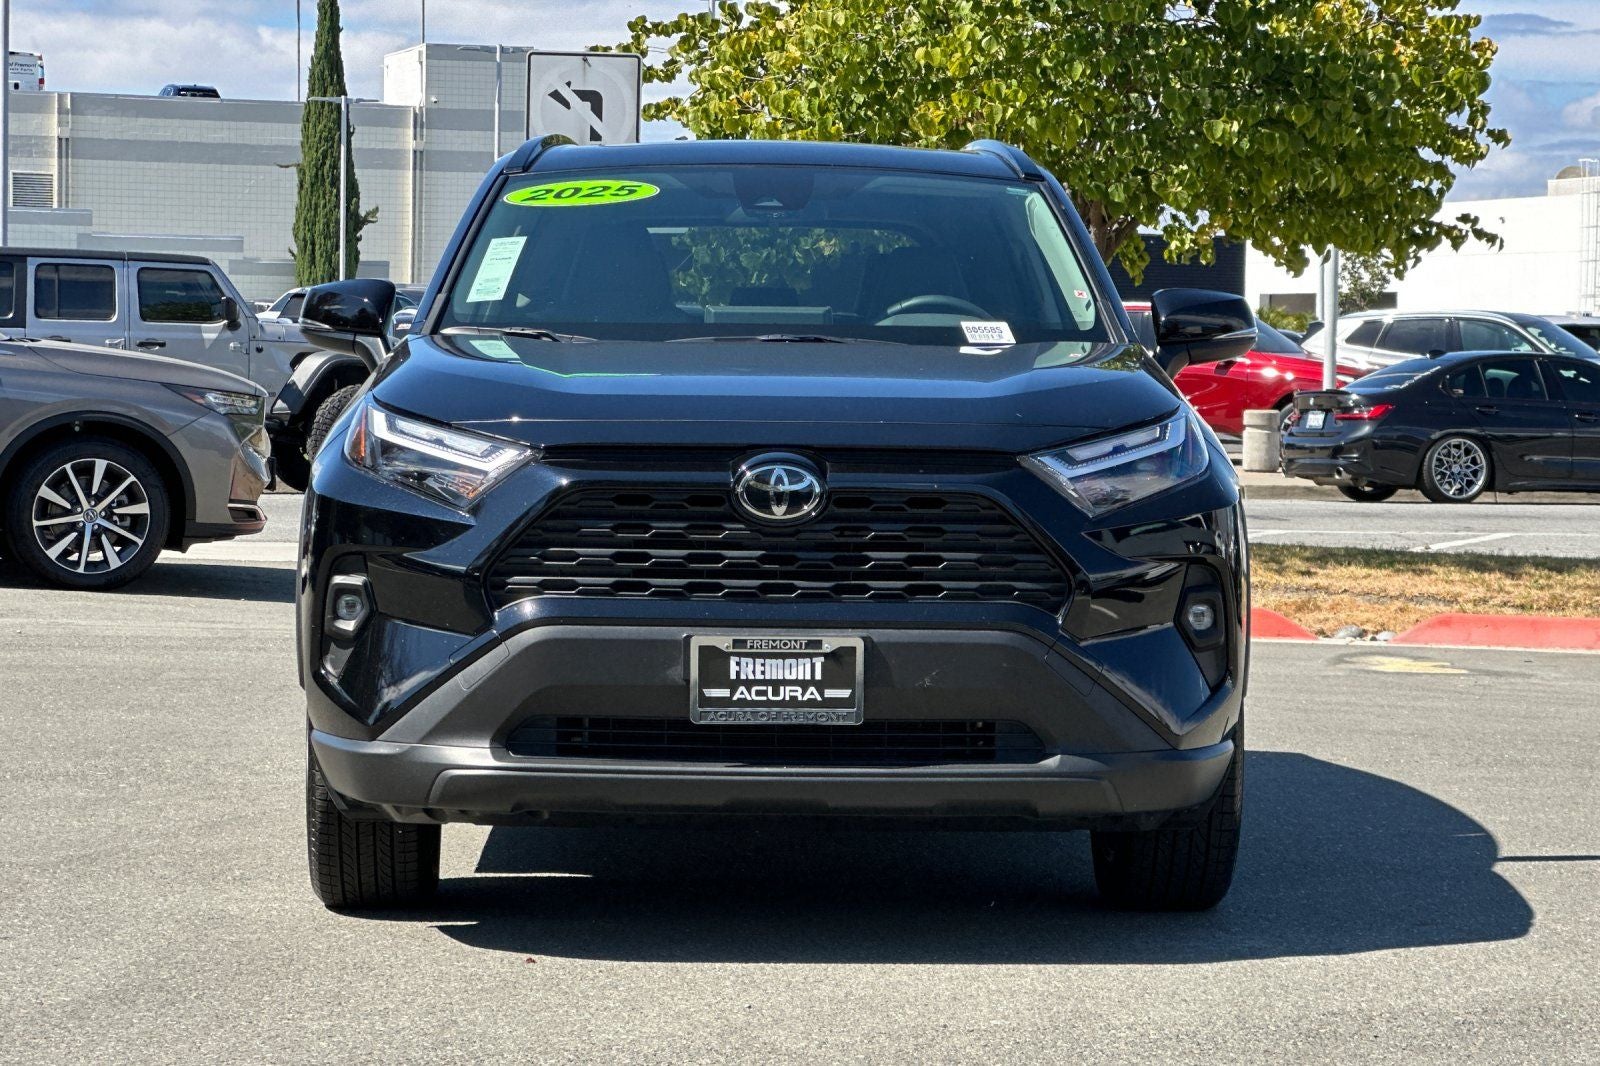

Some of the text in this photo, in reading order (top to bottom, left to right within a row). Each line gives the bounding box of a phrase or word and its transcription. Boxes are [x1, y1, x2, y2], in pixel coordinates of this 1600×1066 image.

[520, 185, 642, 202] 2025
[746, 639, 808, 649] FREMONT
[732, 685, 823, 701] ACURA
[707, 711, 847, 722] ACURA OF FREMONT
